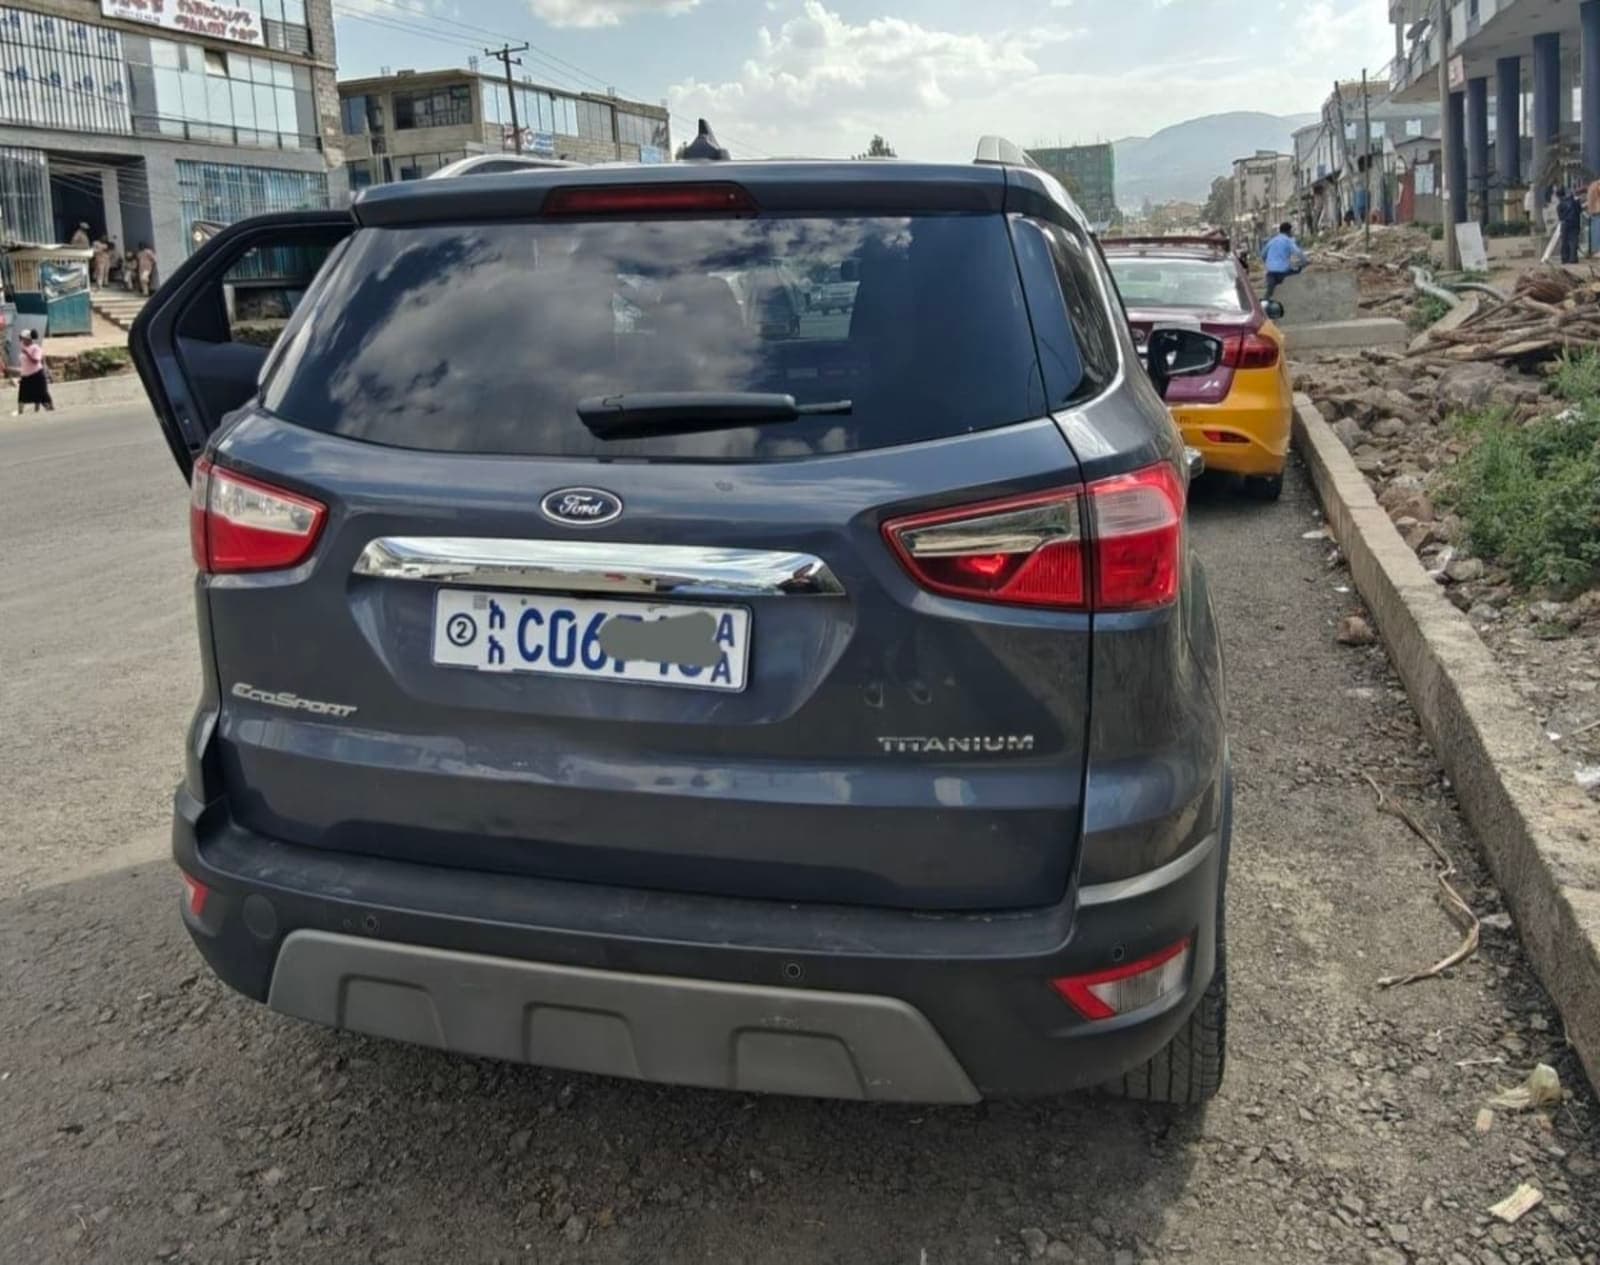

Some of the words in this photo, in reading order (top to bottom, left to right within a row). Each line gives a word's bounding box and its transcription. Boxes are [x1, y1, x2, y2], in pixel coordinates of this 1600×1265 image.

[559, 494, 603, 515] Ford
[517, 607, 703, 678] C06
[877, 735, 1035, 752] TITANIUM
